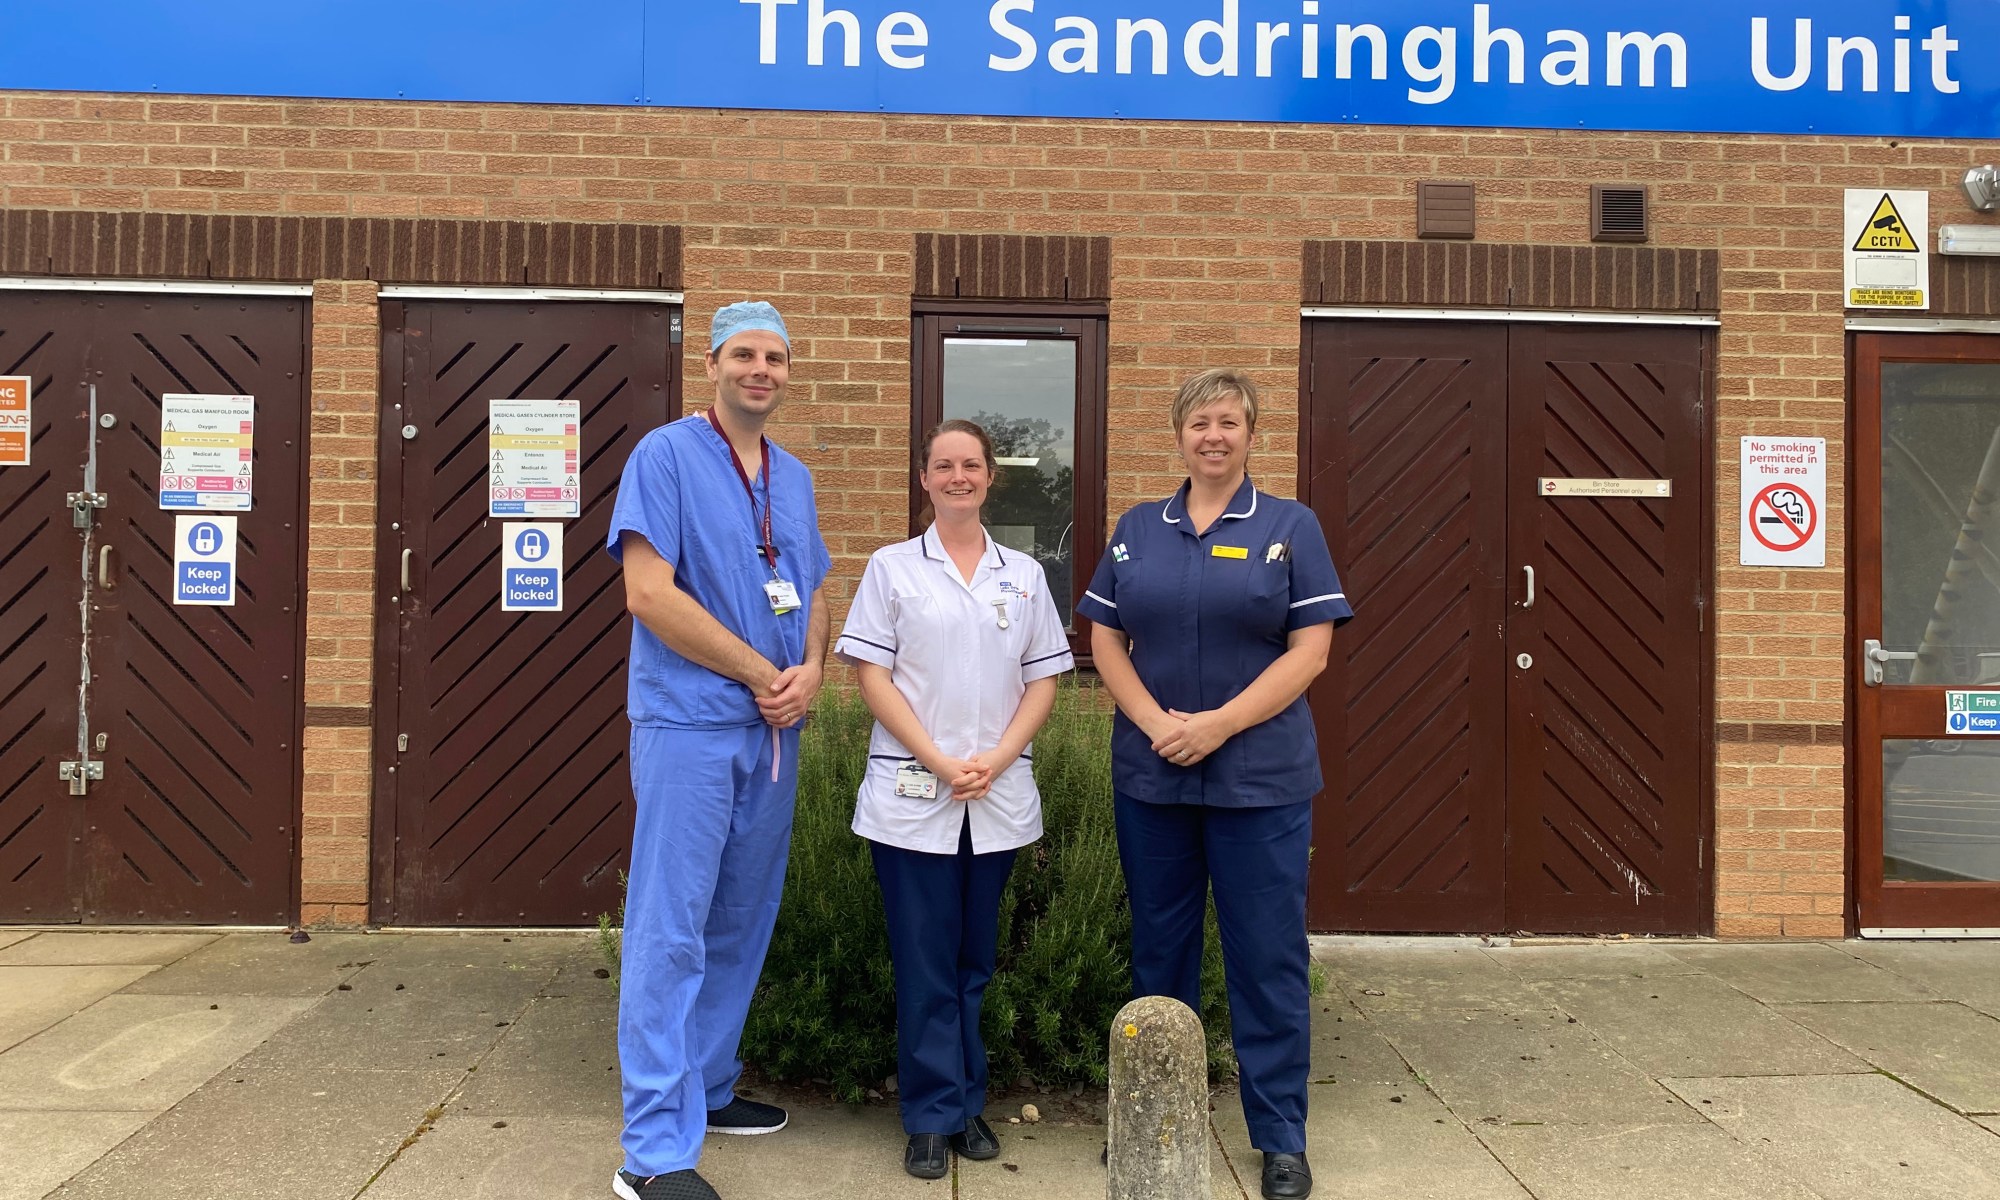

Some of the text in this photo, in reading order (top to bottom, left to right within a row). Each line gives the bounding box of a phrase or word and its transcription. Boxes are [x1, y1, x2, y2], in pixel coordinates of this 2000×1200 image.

[740, 0, 1960, 104] The Sandringham Unit
[1871, 236, 1902, 247] CCTV
[1751, 442, 1816, 454] No smoking
[1749, 454, 1817, 464] permitted in
[1760, 464, 1807, 474] this area
[187, 567, 222, 581] Keep
[515, 573, 549, 587] Keep
[182, 582, 226, 594] locked
[510, 589, 554, 600] locked
[1976, 697, 1997, 707] Fire
[1971, 717, 1997, 728] Keep
